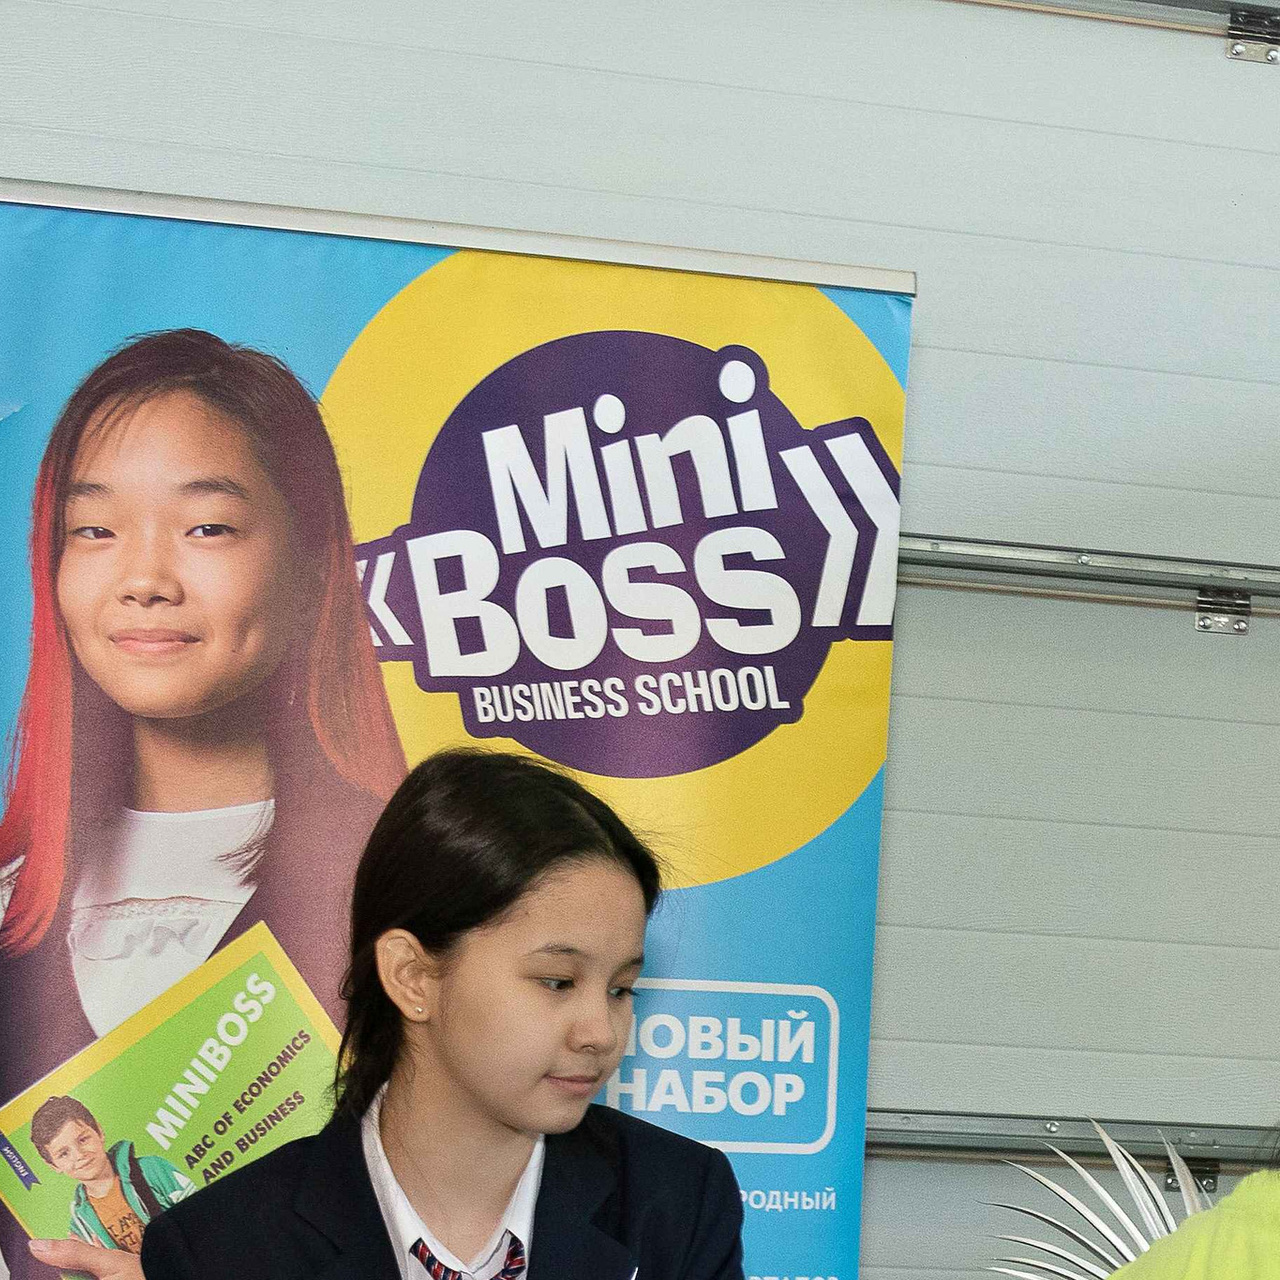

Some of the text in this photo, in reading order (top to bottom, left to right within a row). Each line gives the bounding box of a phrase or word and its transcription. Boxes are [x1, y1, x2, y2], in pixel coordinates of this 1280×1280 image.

[482, 360, 778, 554] Mini
[473, 666, 790, 723] BUSINESS SCHOOL
[146, 973, 276, 1150] MINIBOSS
[184, 1030, 311, 1169] ABC OF ECONOMICS
[606, 1068, 805, 1116] НАБОР
[202, 1091, 305, 1184] AND BUSINESS
